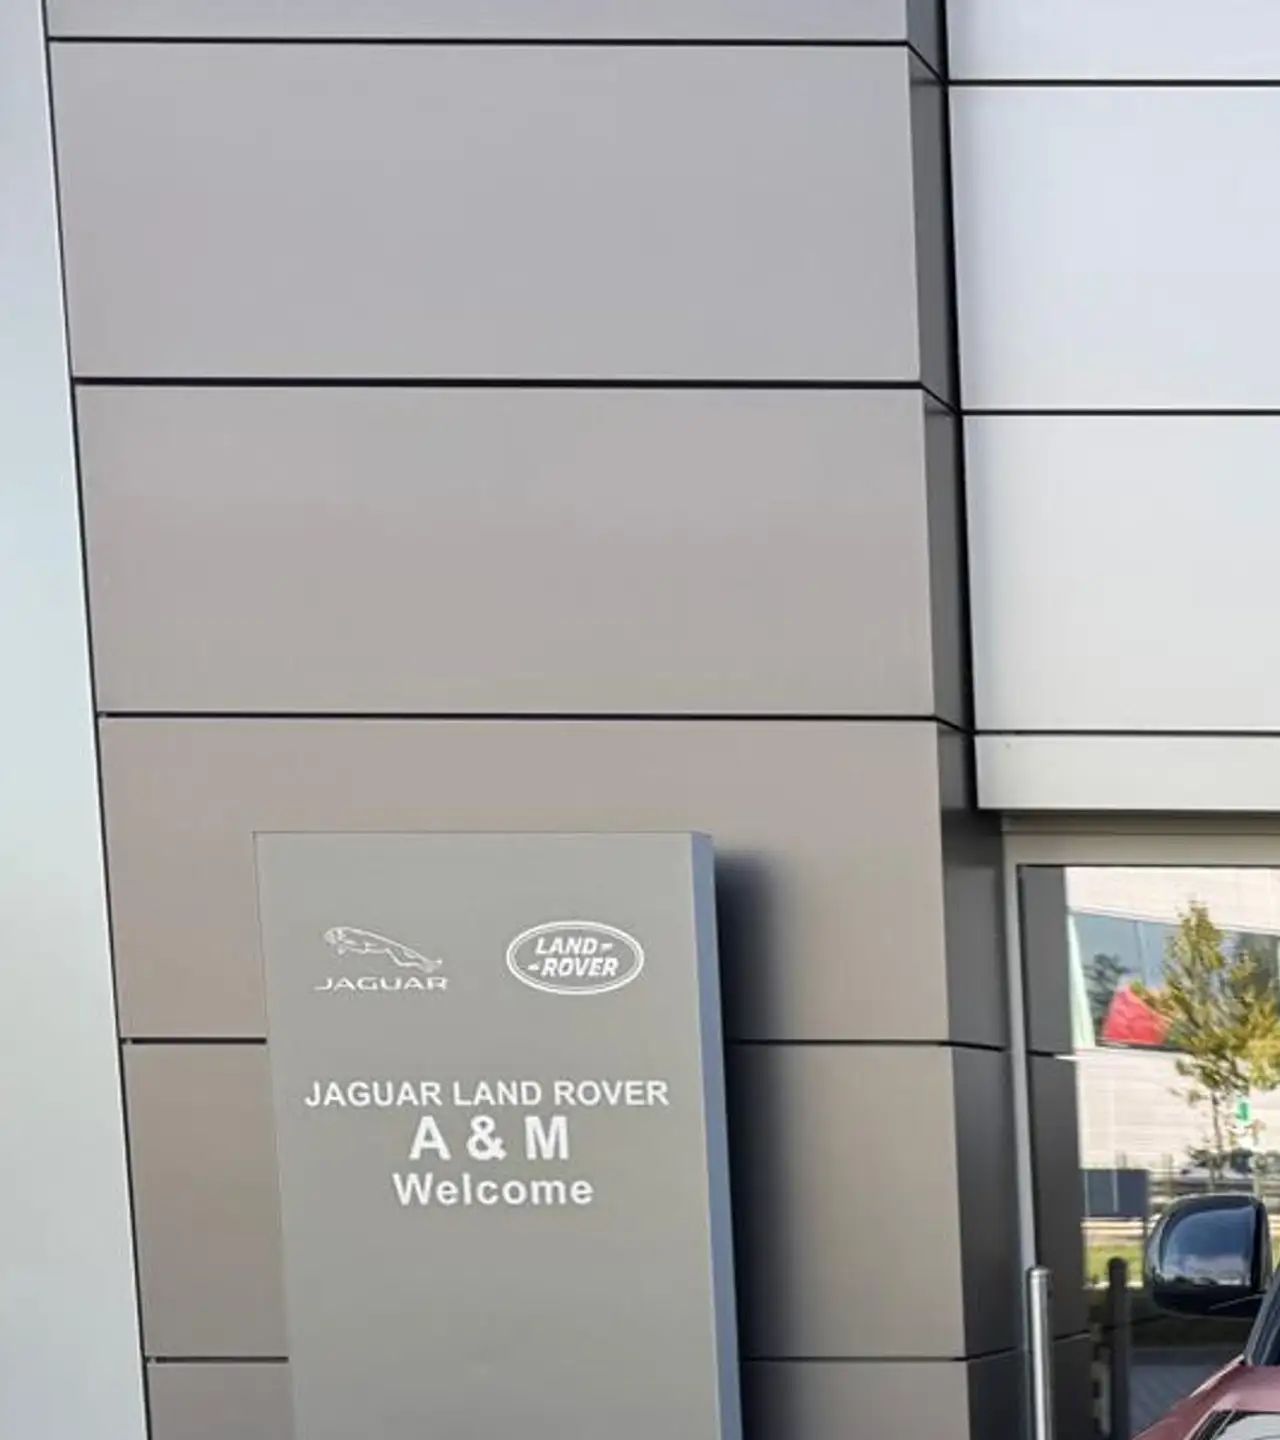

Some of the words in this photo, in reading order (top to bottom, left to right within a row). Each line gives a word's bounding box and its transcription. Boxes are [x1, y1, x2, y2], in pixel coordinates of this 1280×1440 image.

[314, 976, 449, 991] JAGUAR
[304, 1082, 442, 1106] JAGUAR
[453, 1081, 542, 1105] LAND
[554, 1080, 670, 1105] ROVER
[408, 1116, 451, 1160] A
[466, 1116, 507, 1160] &
[525, 1116, 569, 1159] M
[392, 1173, 594, 1206] Welcome
